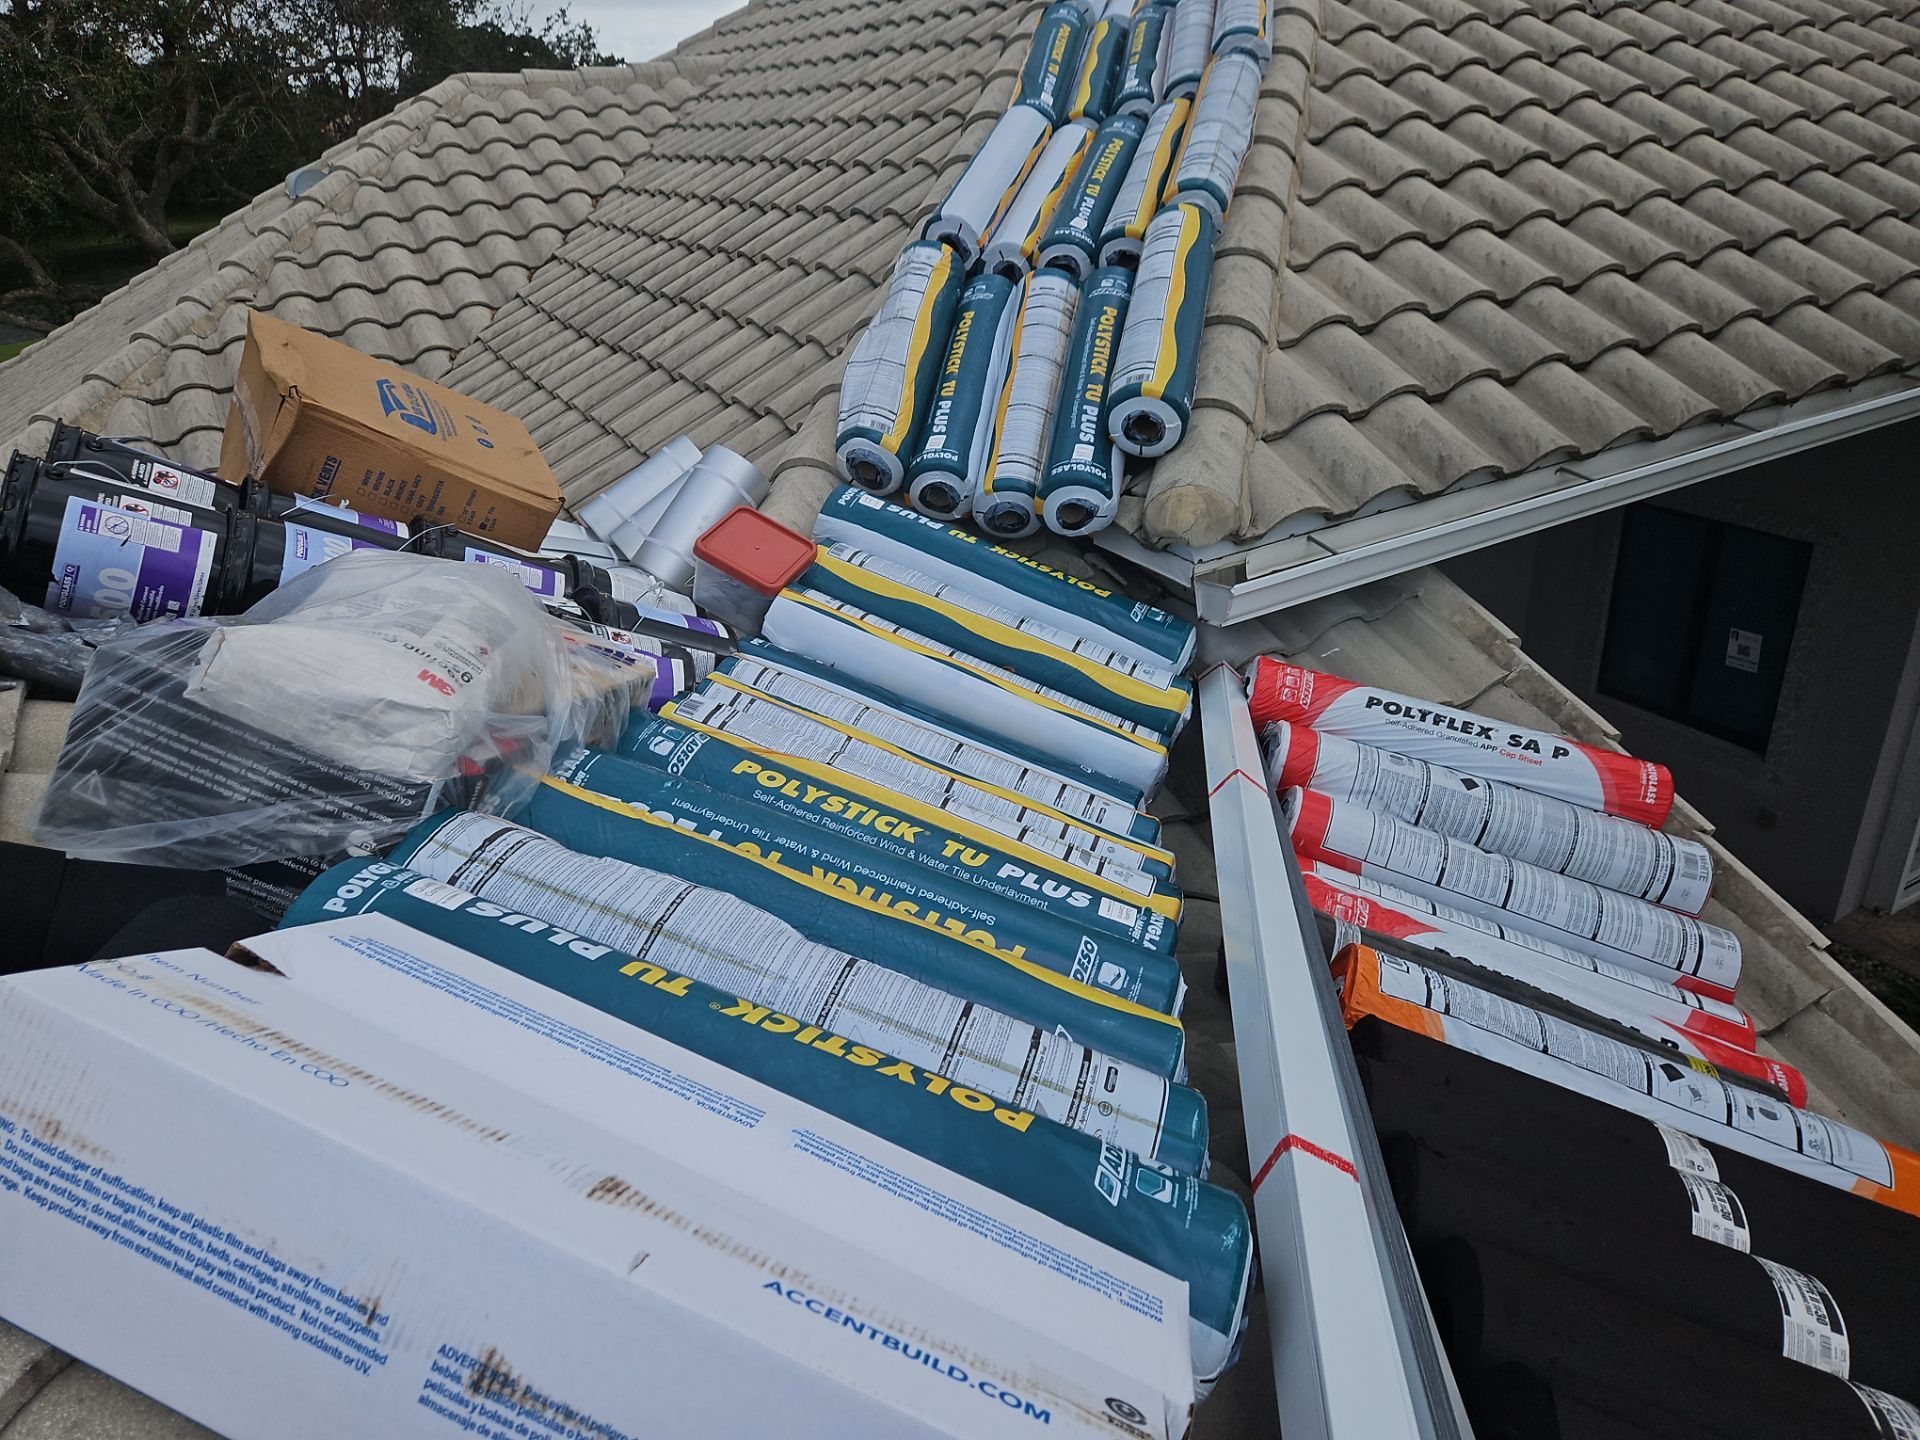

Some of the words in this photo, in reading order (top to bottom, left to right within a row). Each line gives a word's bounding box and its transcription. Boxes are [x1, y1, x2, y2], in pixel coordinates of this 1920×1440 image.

[1092, 138, 1124, 181] POLYSTICK
[1081, 196, 1096, 219] PLUS
[1086, 182, 1101, 198] TU
[945, 311, 975, 376] POLYSTICK
[1088, 306, 1117, 377] POLYSTICK
[939, 380, 955, 397] TU
[1085, 380, 1103, 402] TU
[932, 399, 953, 433] PLUS
[1080, 405, 1099, 444] PLUS
[317, 454, 337, 487] VENTS
[382, 477, 395, 497] BLACK
[1051, 461, 1106, 479] POLYGLASS
[884, 500, 944, 532] PLUS
[948, 526, 977, 545] TU
[989, 542, 1113, 599] POLYSTICK
[417, 668, 456, 697] 3M
[1365, 695, 1494, 740] POLYFLEX
[1507, 733, 1541, 756] SA
[1551, 743, 1570, 761] P
[1479, 742, 1499, 754] APP
[1499, 747, 1517, 760] Cap
[1518, 751, 1544, 767] Sheet
[342, 772, 358, 784] not
[356, 777, 371, 790] Do
[373, 771, 406, 793] staining
[670, 794, 750, 833] Underlayment
[750, 825, 772, 841] Tile
[751, 788, 821, 824] Self-Adhered
[821, 815, 878, 846] Reinforced
[877, 837, 907, 856] Wind
[916, 851, 950, 873] Water
[950, 865, 971, 880] Tile
[970, 872, 1049, 911] Underlayment
[772, 833, 808, 854] Water
[820, 850, 852, 869] Wind
[941, 839, 989, 869] TU
[995, 860, 1093, 910] PLUS
[854, 863, 916, 895] Reinforced
[917, 888, 997, 926] Self-Adhered
[465, 890, 612, 966] PLUS
[186, 973, 262, 1005] Number
[617, 950, 695, 1000] TU
[128, 988, 149, 999] In
[269, 1049, 297, 1065] En
[300, 1063, 350, 1088] COO
[4, 1138, 18, 1154] Do
[16, 1148, 34, 1163] not
[31, 1156, 50, 1171] use
[48, 1165, 82, 1187] plastic
[81, 1178, 101, 1197] film
[100, 1190, 113, 1202] or
[111, 1194, 136, 1214] bags
[136, 1205, 147, 1219] in
[146, 1213, 159, 1224] or
[157, 1218, 180, 1235] near
[179, 1230, 205, 1252] cribs,
[205, 1241, 231, 1266] beds,
[232, 1258, 279, 1290] carriages,
[280, 1282, 322, 1313] strollers,
[323, 1305, 336, 1317] or
[333, 1311, 380, 1343] playpens.
[20, 1128, 31, 1143] To
[30, 1137, 58, 1156] avoid
[56, 1149, 91, 1172] danger
[90, 1166, 103, 1178] of
[100, 1172, 156, 1208] suffocation,
[156, 1197, 181, 1219] keep
[179, 1212, 194, 1224] all
[190, 1218, 224, 1240] plastic
[224, 1232, 243, 1250] film
[242, 1244, 264, 1261] and
[261, 1251, 286, 1272] bags
[286, 1266, 313, 1288] away
[312, 1277, 336, 1298] from
[335, 1289, 368, 1316] babies
[11, 1160, 34, 1181] bags
[32, 1175, 50, 1189] are
[49, 1183, 67, 1198] not
[66, 1189, 89, 1211] toys;
[90, 1202, 104, 1216] do
[103, 1210, 122, 1225] not
[120, 1218, 148, 1237] allow
[146, 1231, 185, 1258] children
[184, 1249, 196, 1262] to
[193, 1256, 217, 1276] play
[216, 1268, 237, 1284] with
[237, 1276, 256, 1294] this
[254, 1288, 295, 1316] product.
[299, 1308, 318, 1327] Not
[316, 1320, 388, 1365] recommended
[22, 1185, 48, 1207] Keep
[46, 1200, 86, 1225] product
[85, 1219, 112, 1239] away
[110, 1229, 134, 1249] from
[134, 1243, 172, 1269] extreme
[171, 1260, 194, 1280] heat
[192, 1274, 213, 1290] and
[211, 1284, 248, 1309] contact
[248, 1303, 268, 1320] with
[268, 1314, 302, 1340] strong
[300, 1331, 342, 1360] oxidants
[342, 1354, 355, 1366] or
[354, 1358, 371, 1376] UV.
[763, 1280, 1051, 1425] ACCENTBUILD.COM
[418, 1394, 476, 1431] almacenaje
[476, 1423, 491, 1437] de
[423, 1378, 470, 1408] películas
[478, 1403, 514, 1430] bolsas
[514, 1422, 529, 1436] de
[430, 1359, 462, 1385] bebés.
[515, 1402, 566, 1435] películas
